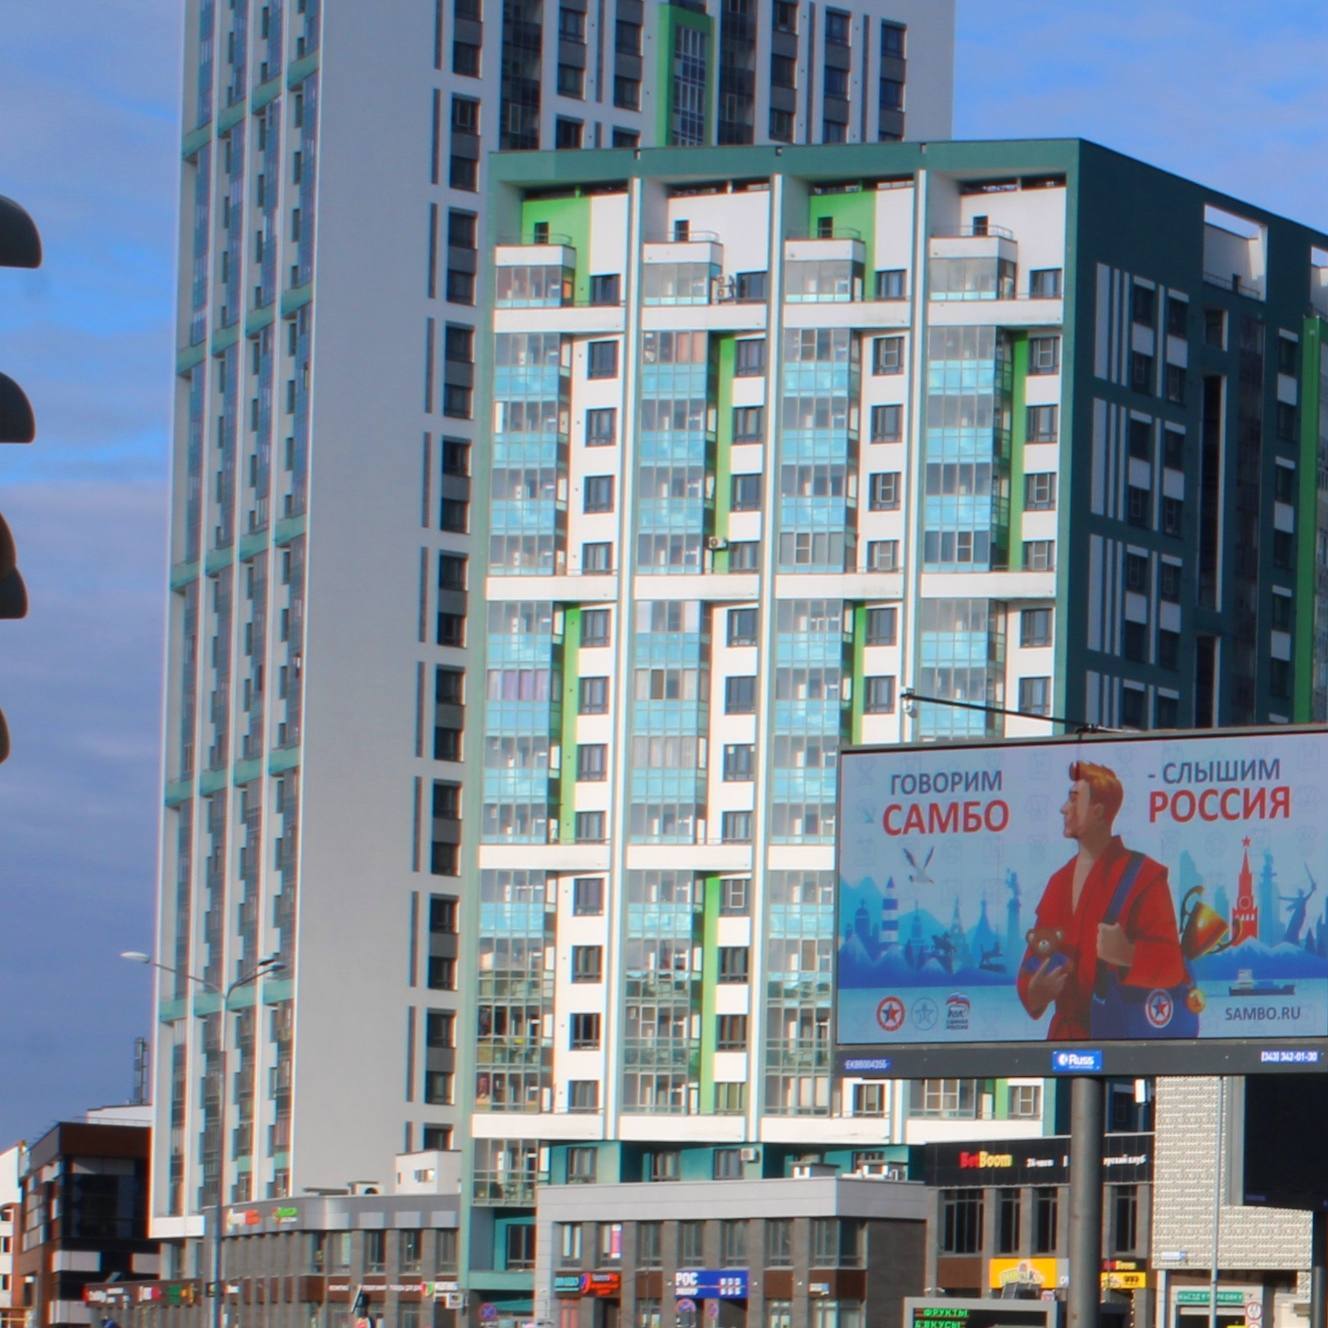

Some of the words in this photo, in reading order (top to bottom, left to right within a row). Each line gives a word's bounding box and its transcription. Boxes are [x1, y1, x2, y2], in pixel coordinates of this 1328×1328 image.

[891, 770, 1002, 795] ГОВОРИМ
[1163, 758, 1280, 784] СЛЫШИМ
[1150, 786, 1290, 823] РОССИЯ
[883, 799, 1010, 836] САМБО
[1225, 1007, 1301, 1020] SAMBO.RU
[959, 1151, 1013, 1168] BetBoom
